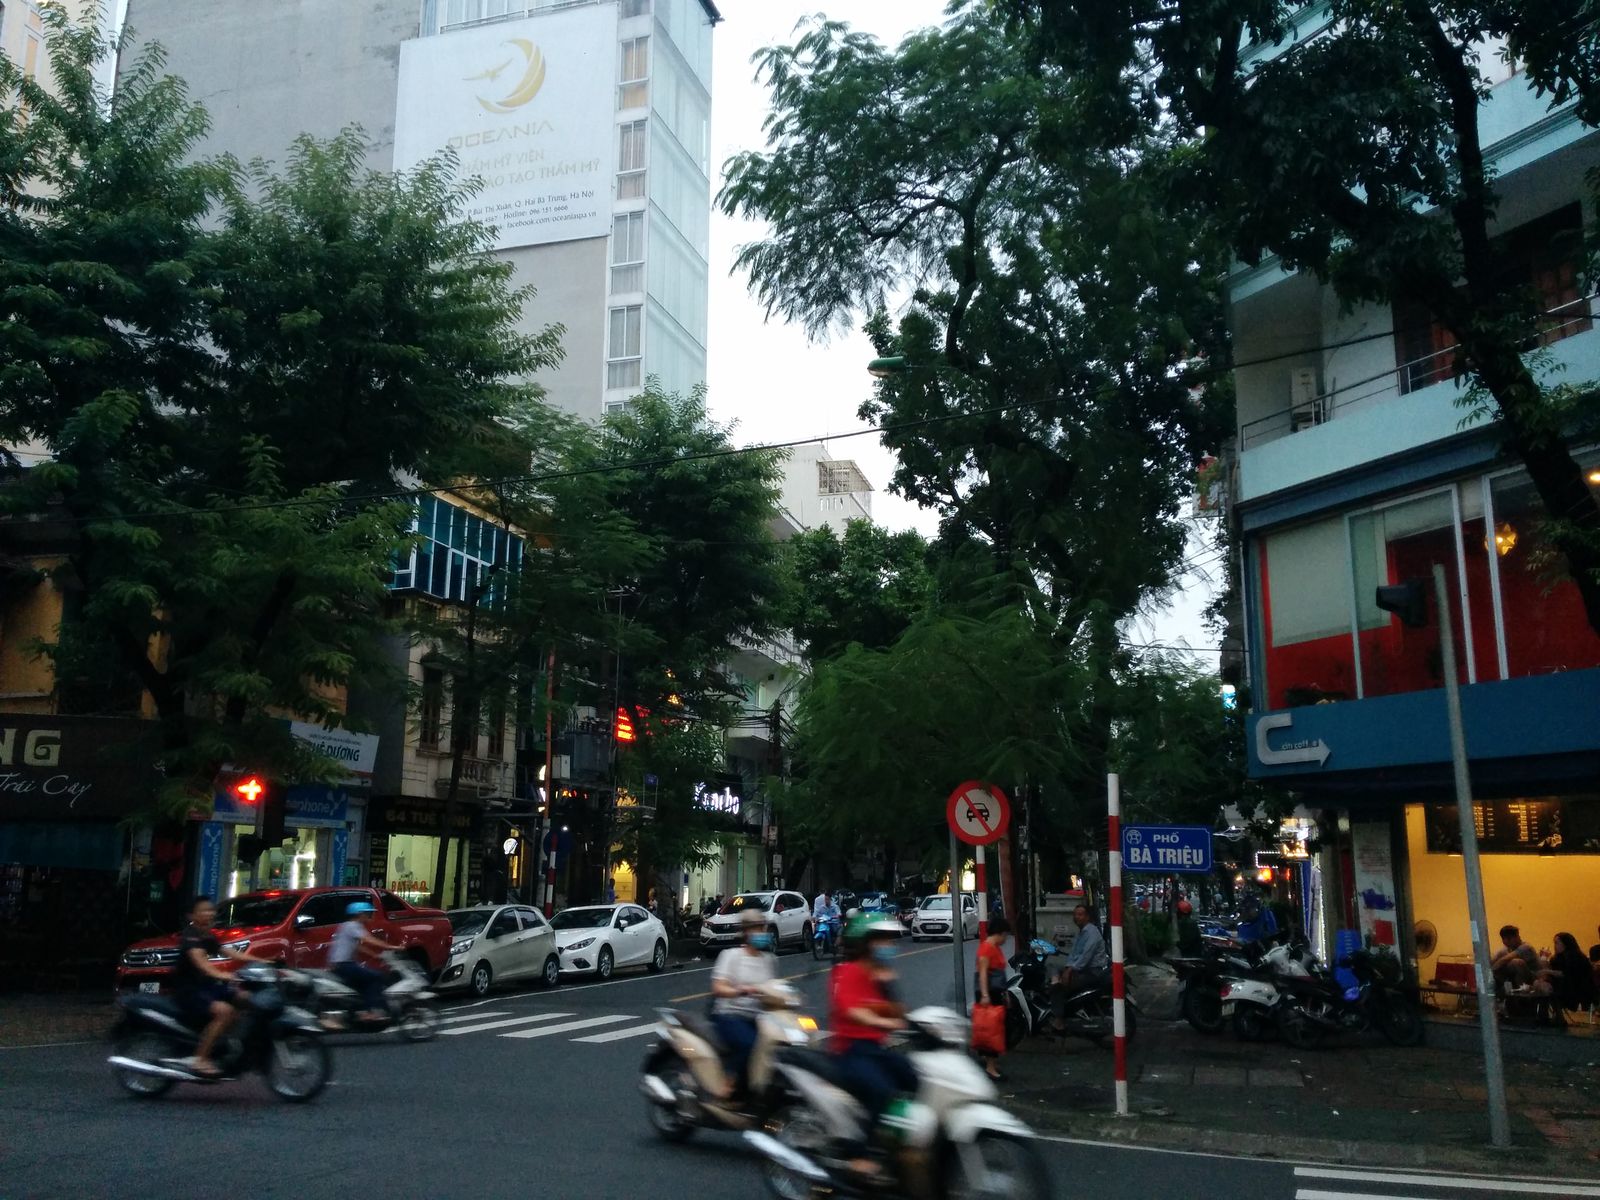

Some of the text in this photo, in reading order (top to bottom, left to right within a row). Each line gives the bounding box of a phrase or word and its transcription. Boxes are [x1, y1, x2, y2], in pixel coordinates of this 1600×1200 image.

[448, 120, 555, 149] OCEANIA
[1153, 831, 1180, 843] PHỐ
[1130, 844, 1204, 868] BÀ TRIỆU
